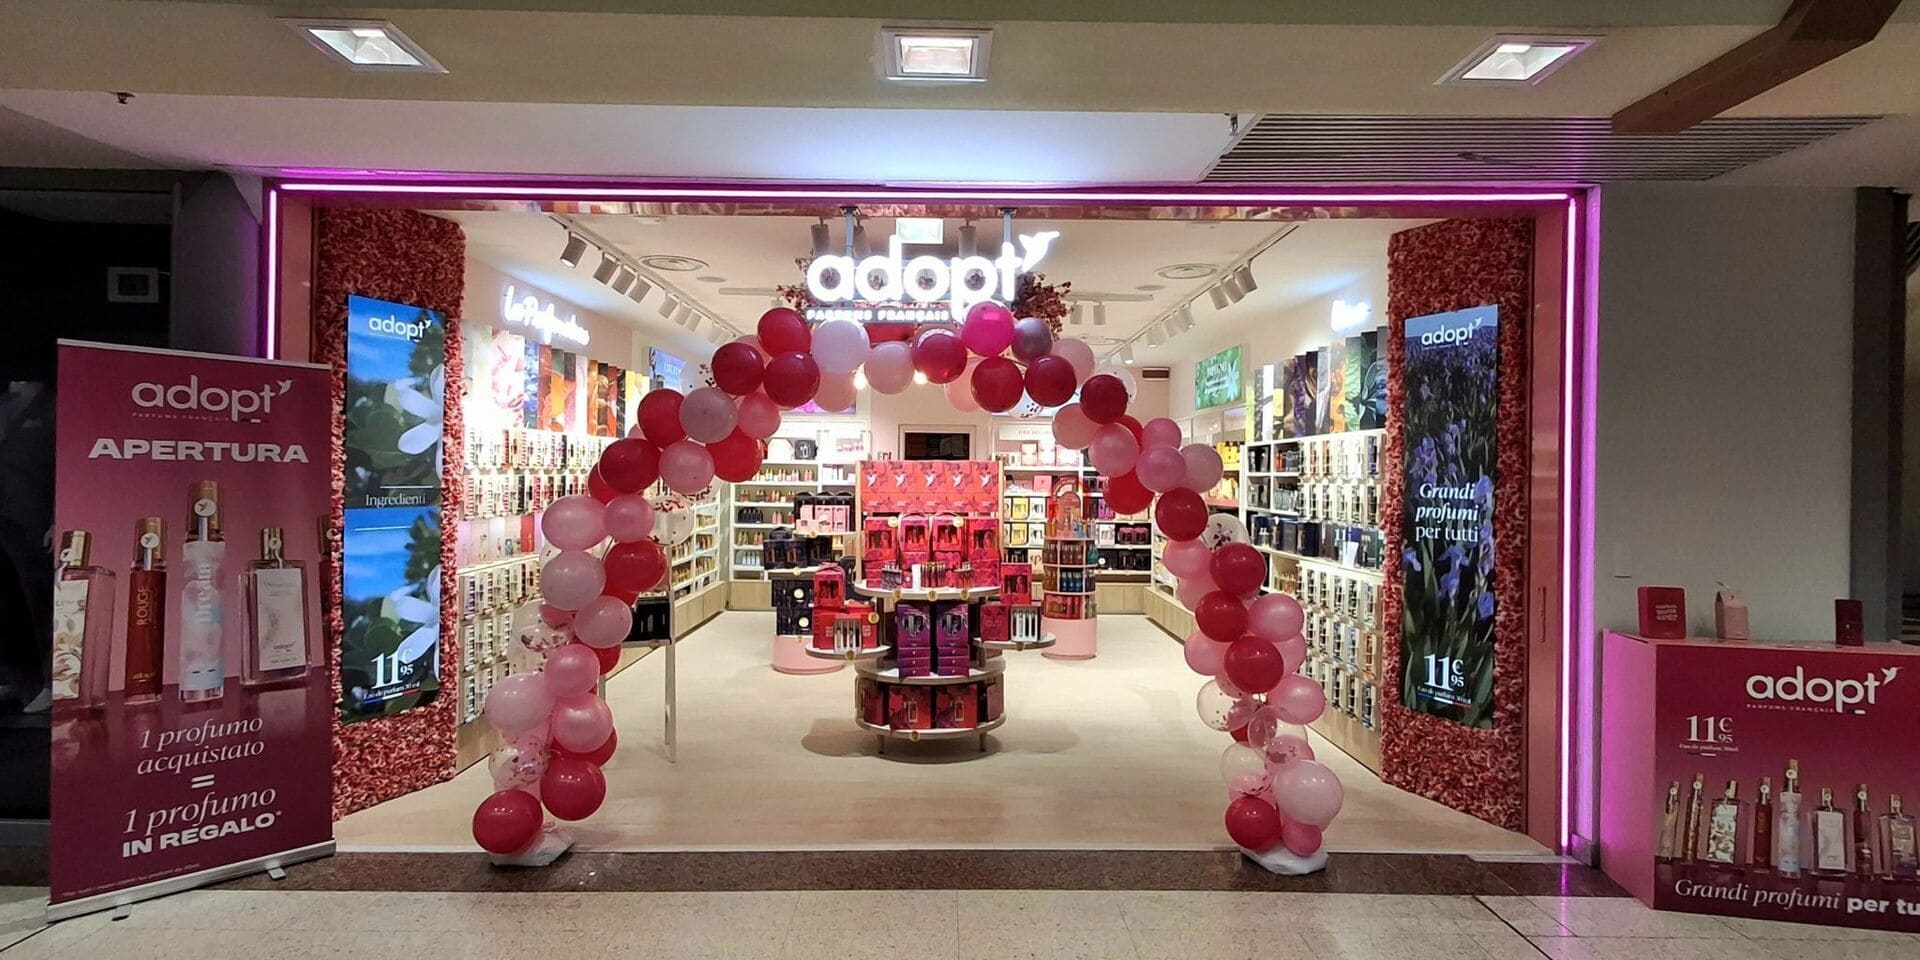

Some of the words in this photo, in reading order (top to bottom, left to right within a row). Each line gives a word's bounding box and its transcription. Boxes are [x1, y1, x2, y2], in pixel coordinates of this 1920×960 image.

[806, 234, 1023, 321] adopt
[369, 315, 425, 342] adopt
[1421, 322, 1474, 346] adopt
[131, 375, 276, 422] adopt
[88, 438, 309, 463] APERTURA
[365, 493, 426, 508] Ingredienti
[1420, 482, 1475, 500] Grandi
[1415, 502, 1479, 523] profumi
[1415, 526, 1441, 542] per
[1445, 526, 1478, 542] tutti
[136, 585, 150, 626] ROUGE
[1746, 665, 1881, 713] adopt
[140, 729, 151, 749] 1
[157, 717, 264, 752] profumo
[137, 741, 265, 775] acquistato
[123, 809, 137, 834] 1
[145, 788, 277, 836] profumo
[122, 837, 153, 858] IN
[1675, 879, 1749, 900] Grandi
[1752, 887, 1840, 911] profumi
[1846, 897, 1890, 914] per
